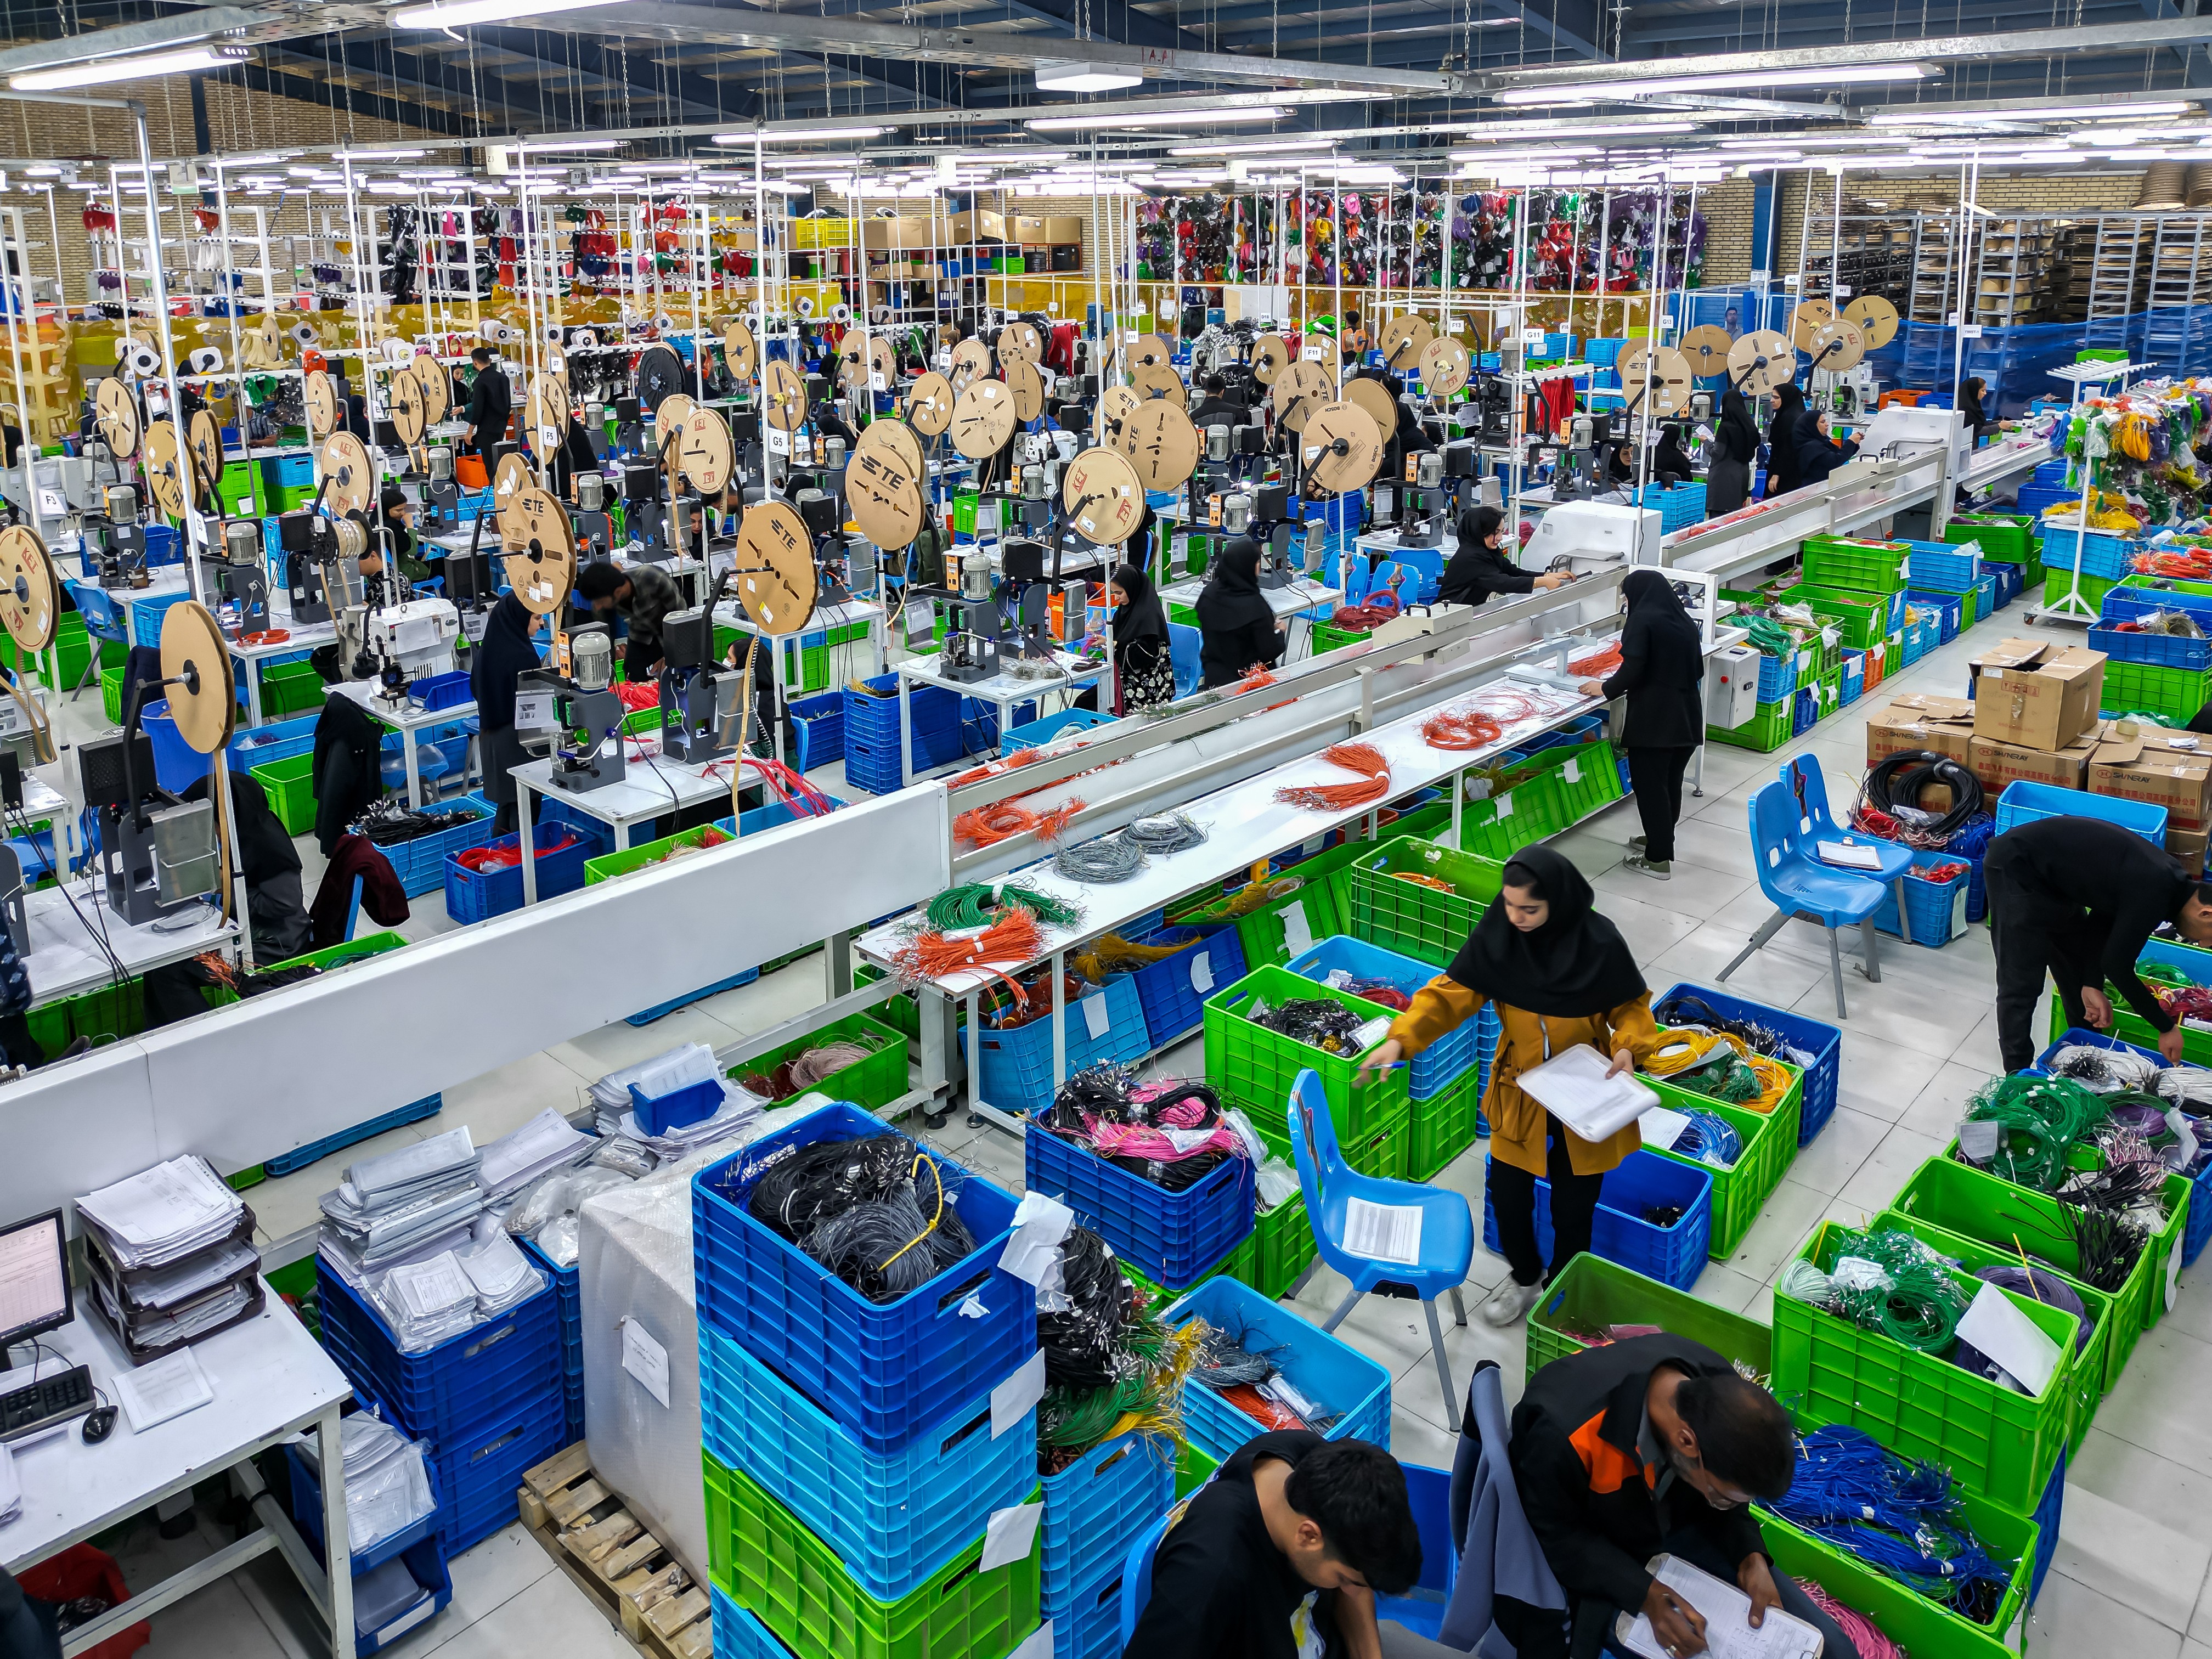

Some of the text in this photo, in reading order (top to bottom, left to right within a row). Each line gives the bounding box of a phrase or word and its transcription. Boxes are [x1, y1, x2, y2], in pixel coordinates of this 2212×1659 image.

[1430, 343, 1442, 358] KET
[695, 417, 707, 432] KET
[546, 432, 554, 441] F5
[773, 436, 783, 447] G5
[339, 441, 354, 457] KET
[1072, 466, 1088, 494] KET
[46, 495, 57, 505] F3
[1116, 498, 1133, 527] KET
[21, 546, 39, 575] KET
[1994, 749, 2029, 762] SHINERAY
[2112, 771, 2151, 783] SHINERAY
